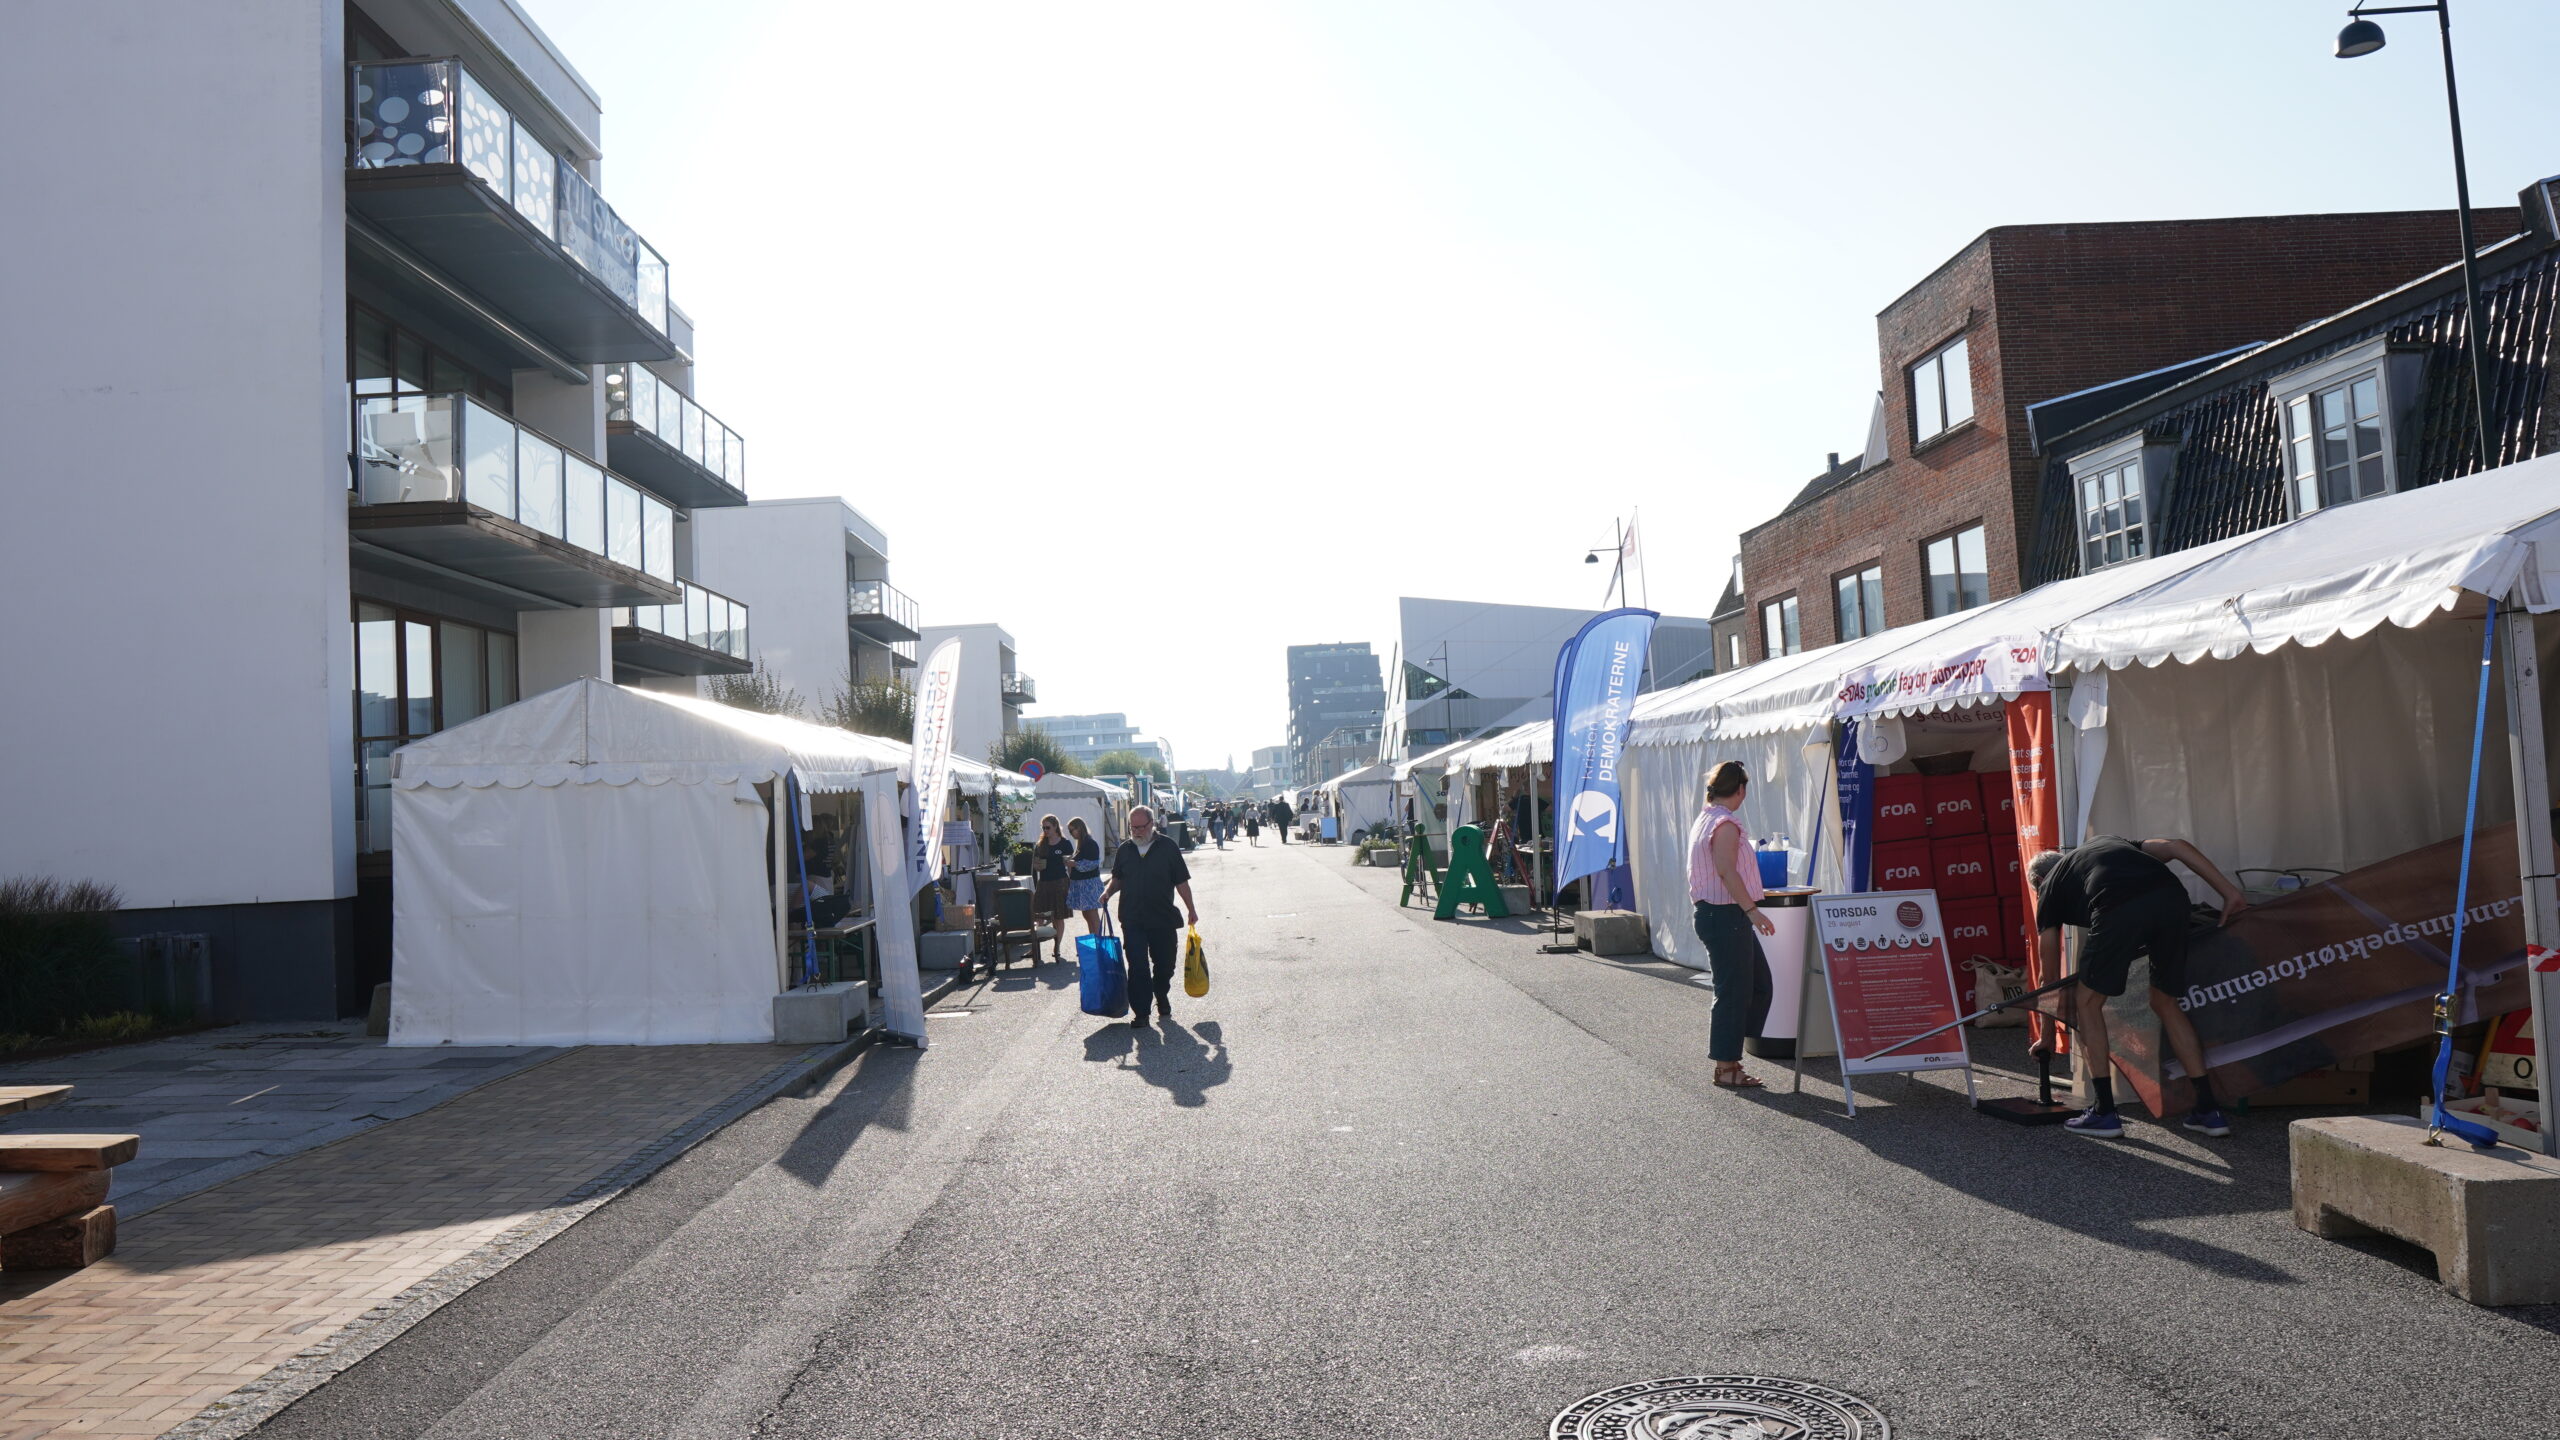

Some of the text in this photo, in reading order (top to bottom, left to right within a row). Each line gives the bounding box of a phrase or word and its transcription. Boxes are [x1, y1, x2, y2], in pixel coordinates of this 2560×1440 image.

[2010, 646, 2038, 663] FOA
[1898, 672, 1914, 696] fag
[1915, 672, 1927, 694] og
[1599, 641, 1630, 781] DEMOKRATERNE
[1581, 721, 1599, 779] kristen
[1880, 802, 1917, 818] FOA
[1937, 799, 1973, 814] FOA
[1885, 865, 1921, 881] FOA
[1947, 861, 1982, 876] FOA
[1825, 906, 1878, 918] TORSDAG
[1839, 919, 1862, 929] august
[1953, 925, 1989, 939] FOA
[2176, 895, 2524, 1012] andinspektørforeninge
